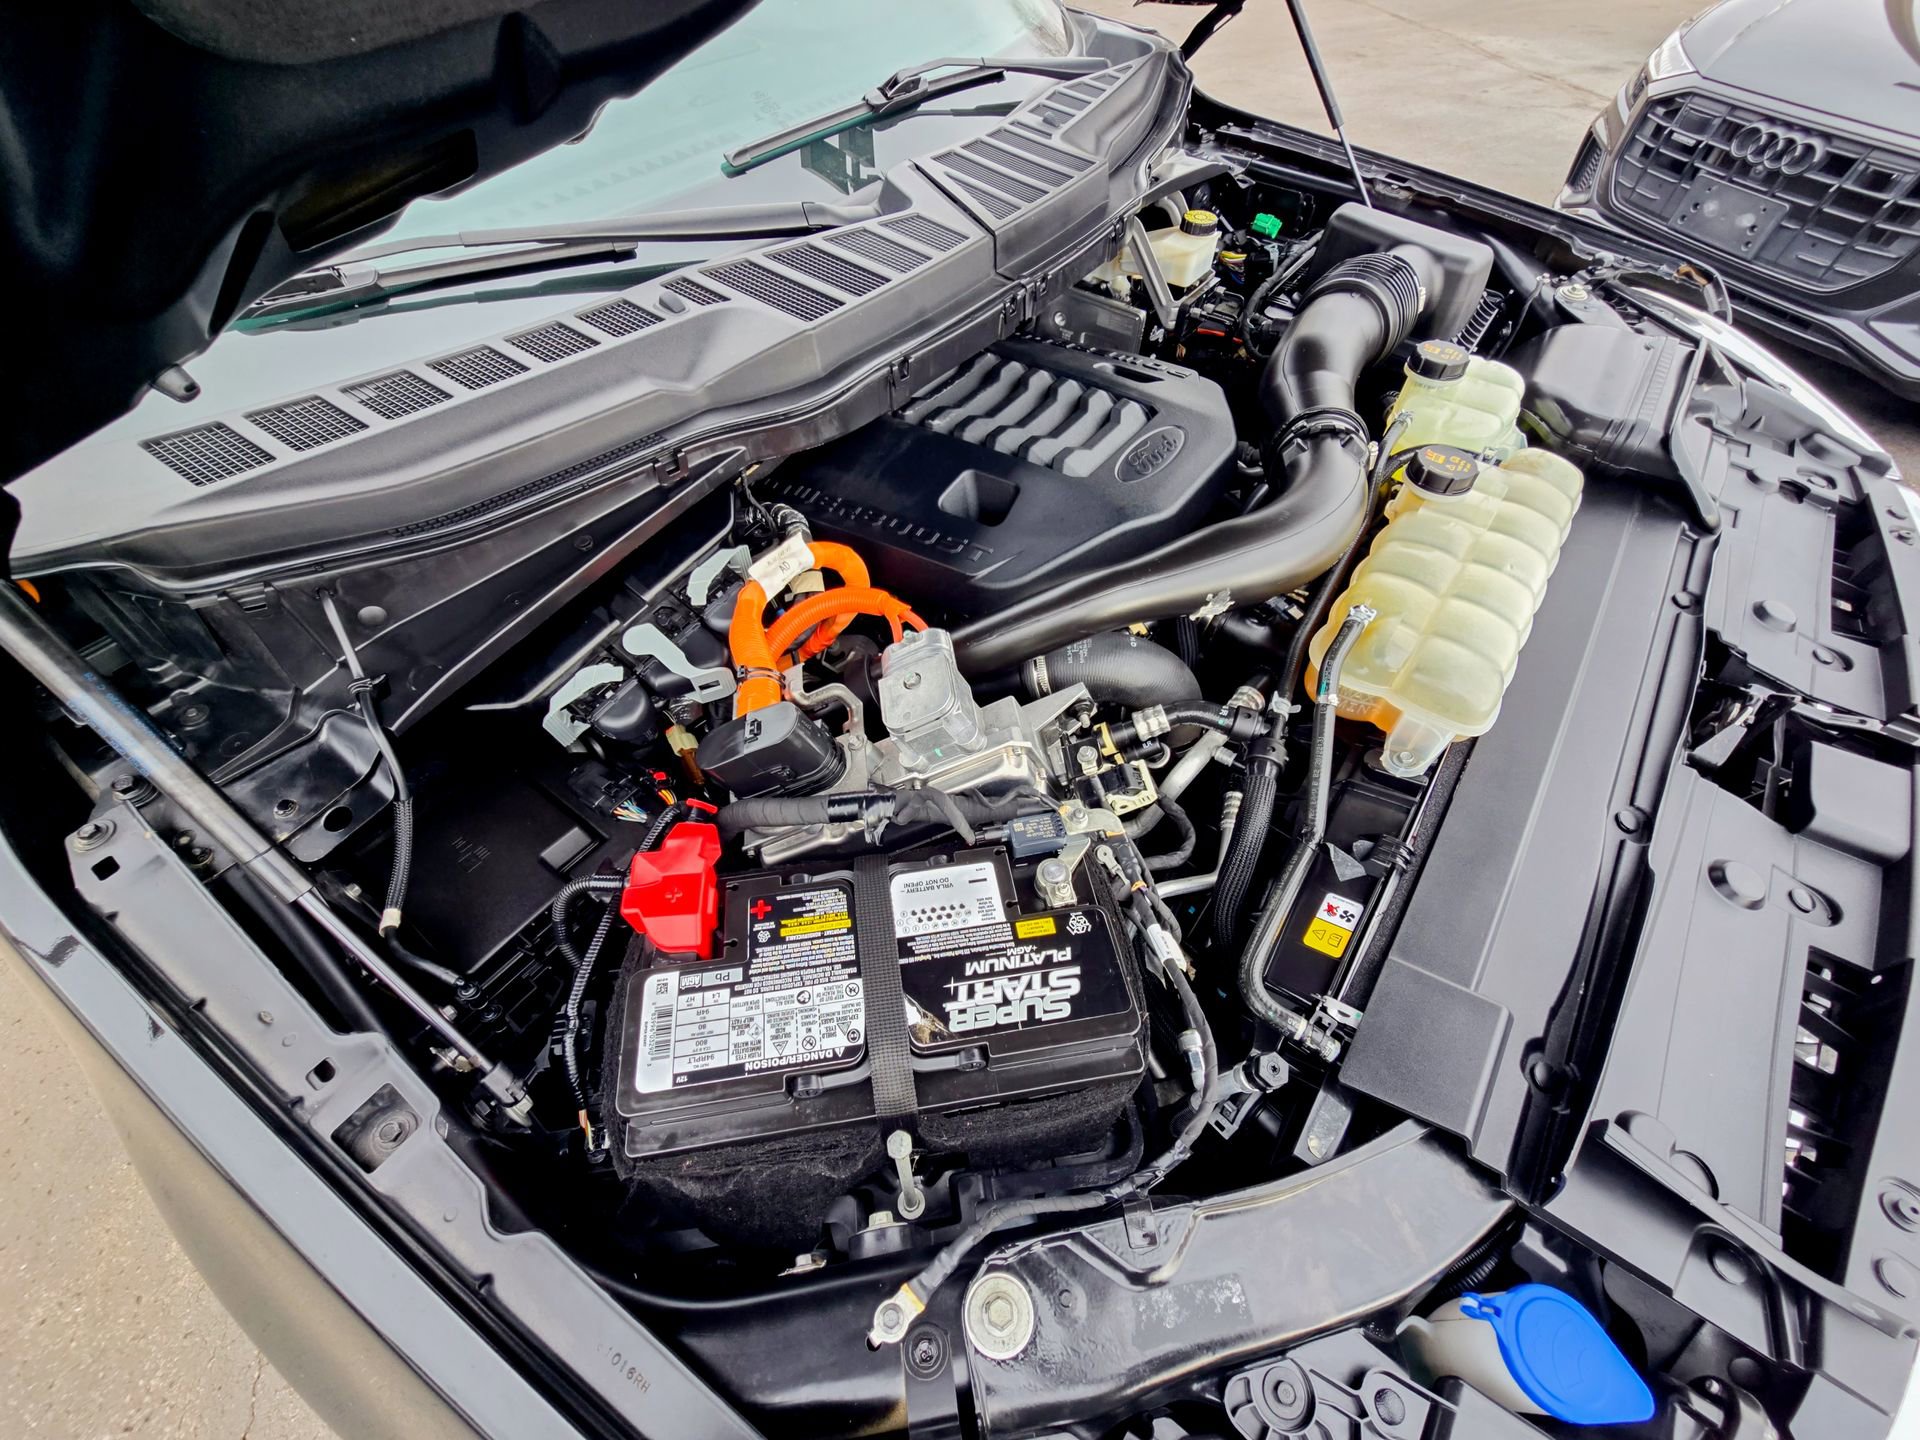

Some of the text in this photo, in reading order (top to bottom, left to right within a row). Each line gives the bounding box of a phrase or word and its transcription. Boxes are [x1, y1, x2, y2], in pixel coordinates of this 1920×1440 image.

[1129, 434, 1178, 475] Ford
[903, 880, 923, 888] OPEN!
[906, 885, 934, 893] BATTERY
[963, 946, 1072, 976] PLATINUM
[678, 974, 700, 987] AGM
[714, 971, 730, 982] Pb
[942, 967, 1080, 1011] START
[695, 1008, 709, 1016] 94R
[948, 991, 1071, 1033] SUPER
[820, 1013, 858, 1025] EXPLOSIVE GASES
[730, 1022, 750, 1030] MEDICAL
[769, 1031, 791, 1040] SULFURIC
[730, 1044, 761, 1055] IMMEDIATELY
[686, 1053, 714, 1063] 94RPLT
[743, 1048, 833, 1071] DANGER/POISON
[675, 1074, 688, 1082] 12V
